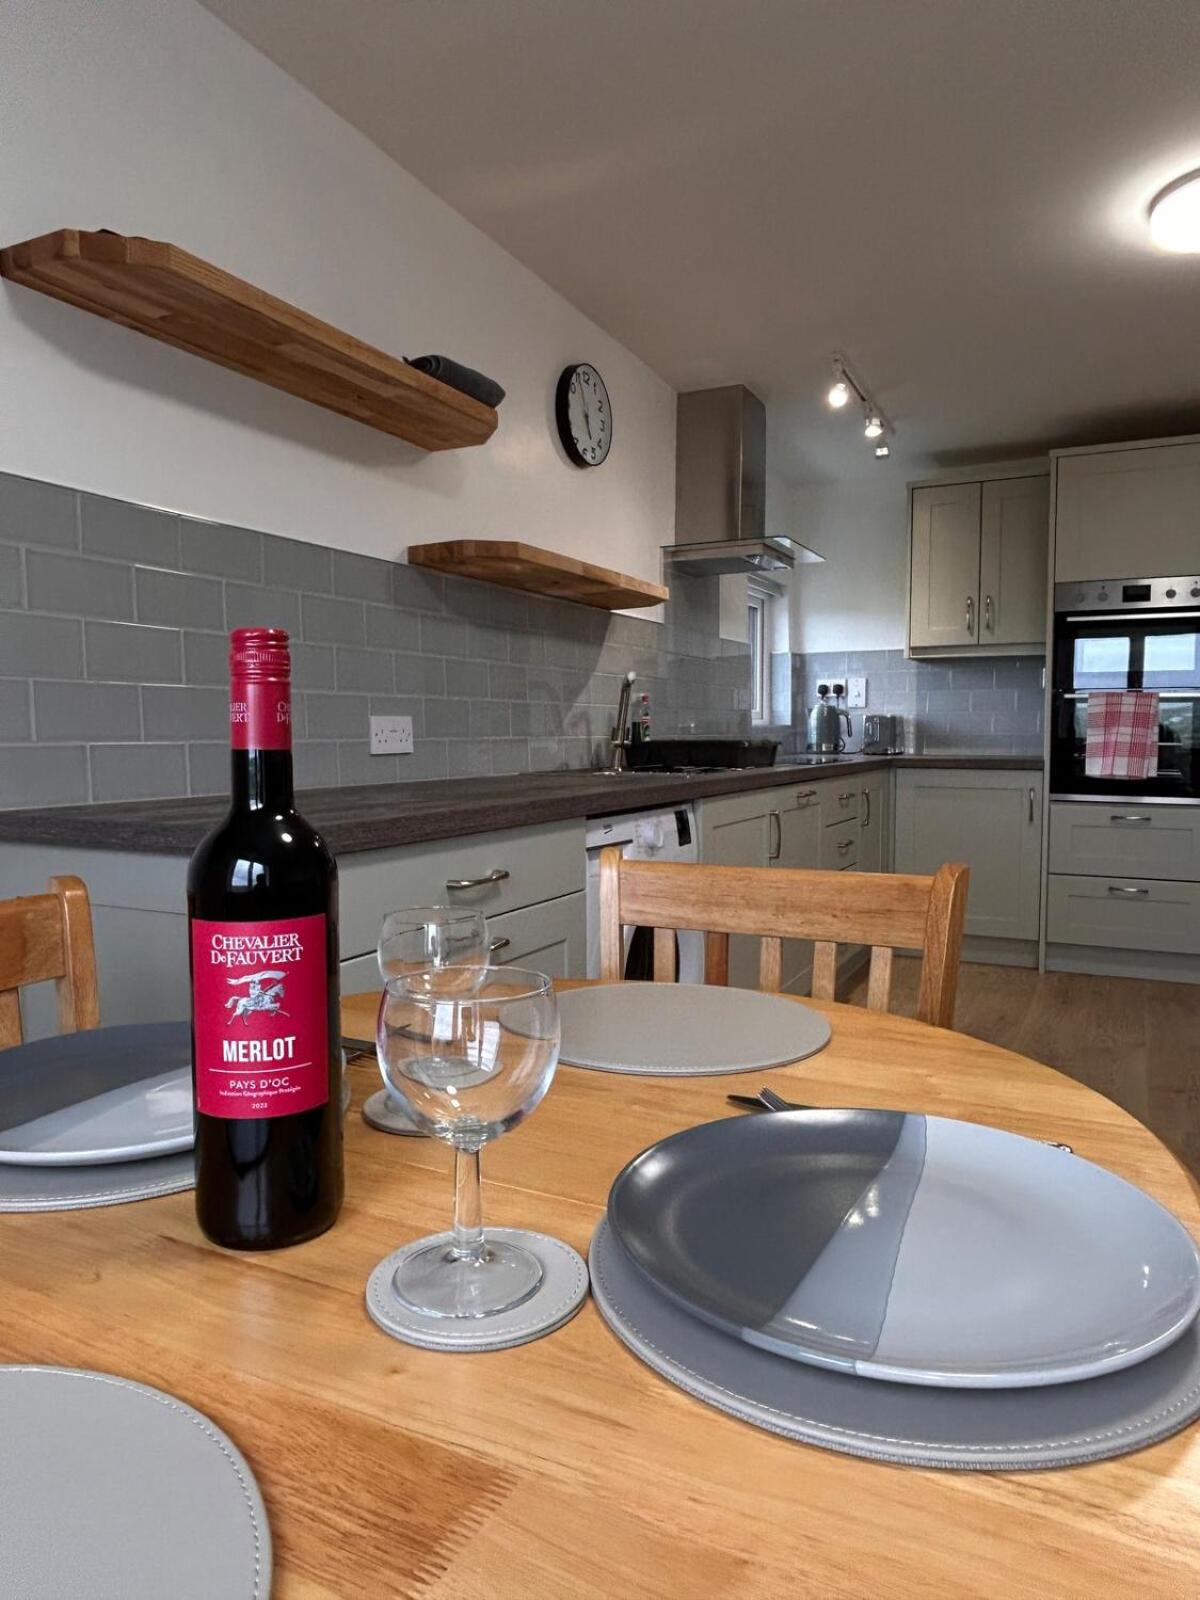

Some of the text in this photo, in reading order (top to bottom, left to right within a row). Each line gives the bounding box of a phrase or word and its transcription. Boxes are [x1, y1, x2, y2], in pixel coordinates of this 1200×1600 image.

[211, 933, 302, 950] CHEVALIER
[223, 1036, 296, 1063] MERLOT
[229, 1076, 290, 1090] PAYS D'OC
